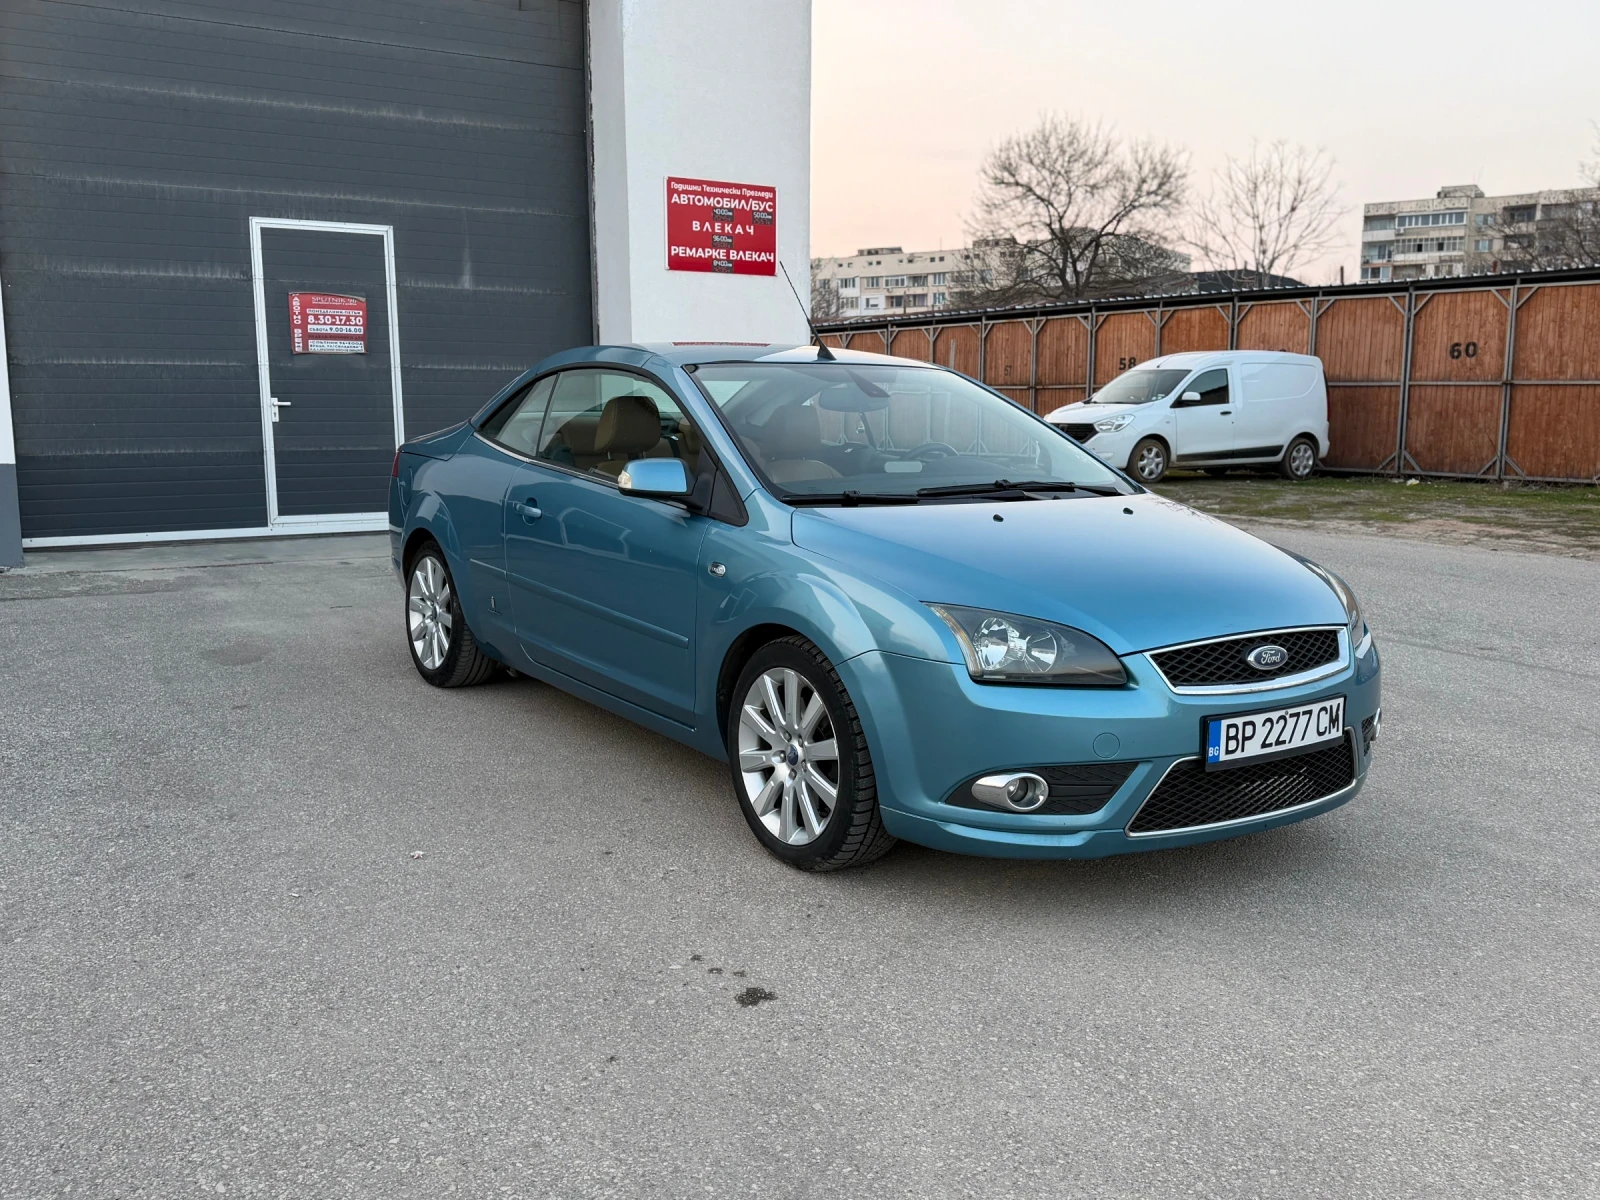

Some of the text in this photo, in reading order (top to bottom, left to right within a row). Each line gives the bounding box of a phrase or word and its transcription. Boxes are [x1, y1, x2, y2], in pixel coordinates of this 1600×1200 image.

[671, 181, 774, 199] Годишни Технически Прегледи
[671, 193, 774, 212] АВТОМОБИЛ/БУС
[692, 220, 754, 235] ВЛЕКАЧ
[671, 246, 774, 262] РЕМАРКЕ ВЛЕКАЧ
[292, 294, 302, 325] АБОТНО
[307, 315, 363, 325] 8.30-17.30
[1449, 341, 1478, 360] 60
[1119, 357, 1137, 371] 58
[1260, 650, 1282, 664] Ford
[1224, 702, 1341, 756] BP 2277 CM
[1208, 746, 1220, 757] BG
